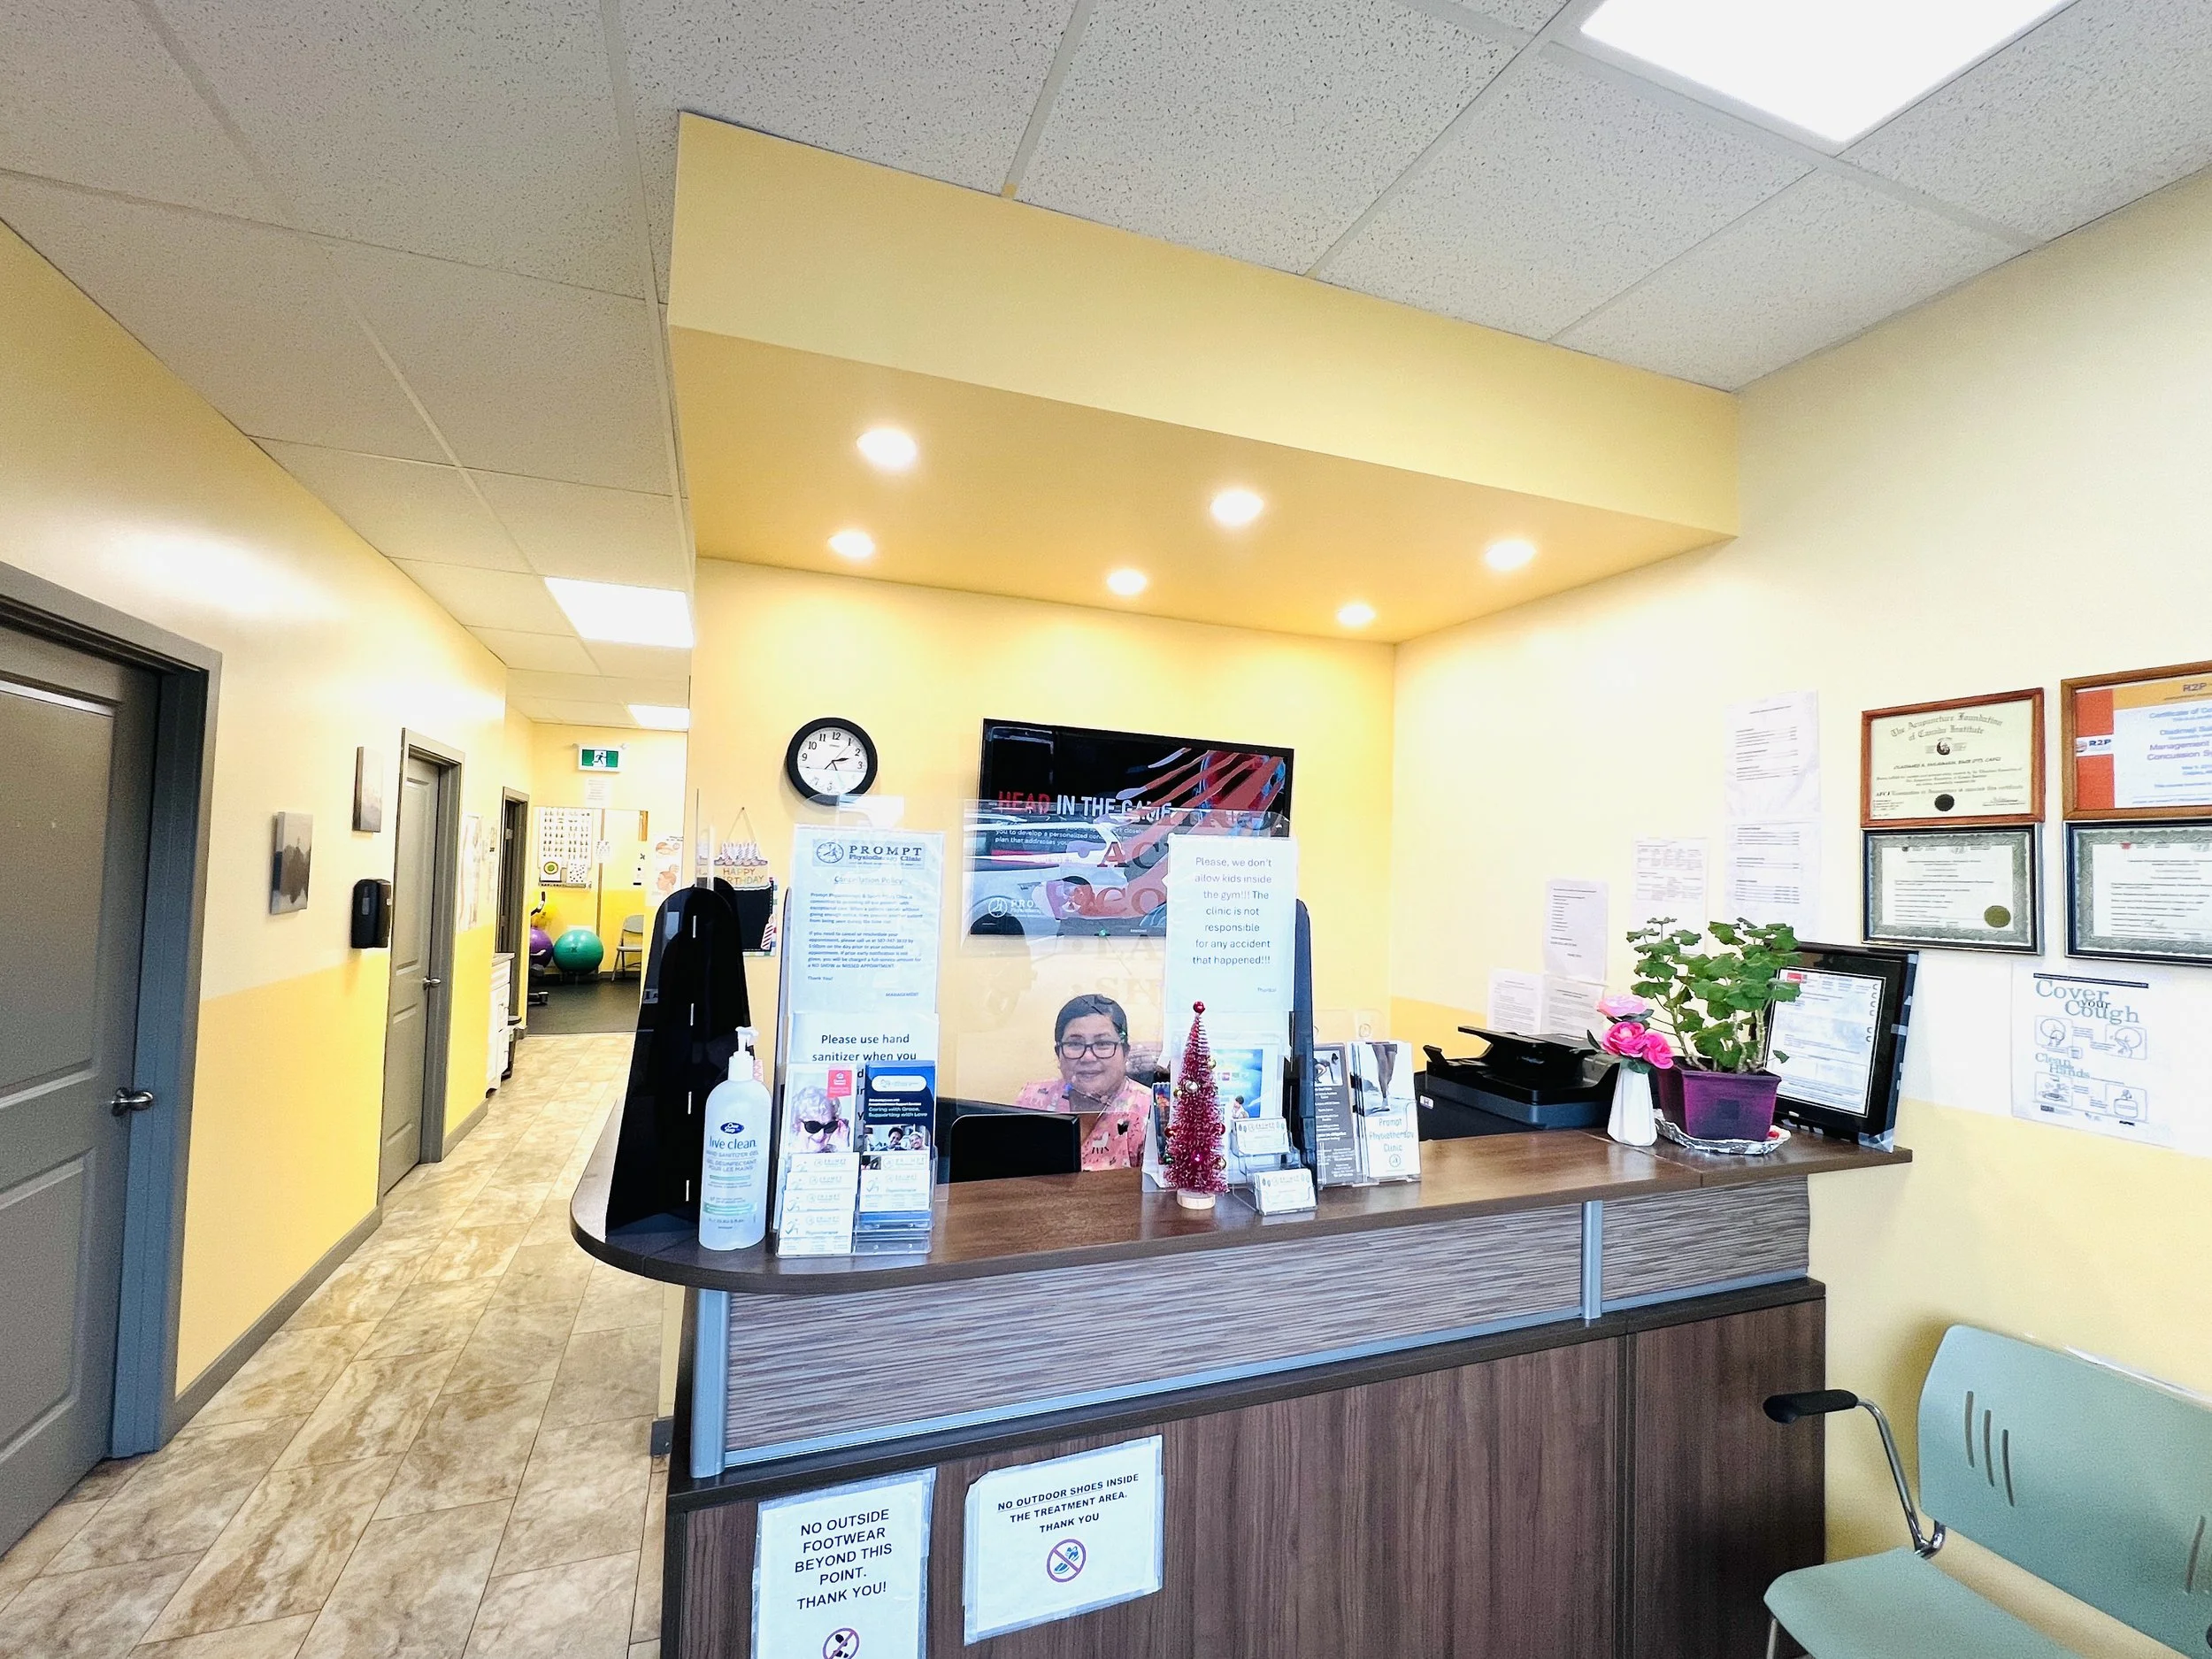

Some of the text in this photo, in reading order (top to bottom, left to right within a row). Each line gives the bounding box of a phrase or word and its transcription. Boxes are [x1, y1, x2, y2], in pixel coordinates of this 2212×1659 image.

[2183, 683, 2207, 692] R2P
[1891, 712, 2003, 737] The Acupuncture Foundation
[1950, 725, 1985, 734] Institute
[2149, 741, 2209, 750] Management
[857, 761, 863, 770] 3
[998, 791, 1050, 814] HEAD
[1056, 795, 1075, 816] IN
[1081, 796, 1117, 817] THE
[849, 845, 922, 856] PROMPT
[1195, 857, 1230, 867] Please,
[1248, 858, 1271, 867] don't
[725, 875, 764, 886] RTHDAY
[1194, 874, 1221, 883] allow
[1222, 874, 1241, 883] kids
[1221, 891, 1250, 901] gym!!!
[1252, 891, 1269, 900] The
[1206, 907, 1232, 916] clinic
[1233, 907, 1241, 916] is
[1205, 924, 1260, 933] responsible
[1210, 941, 1227, 949] any
[1230, 940, 1271, 949] accident
[1214, 956, 1271, 966] happened!!!
[2035, 979, 2109, 1002] Cover
[2080, 999, 2111, 1010] your
[2064, 999, 2140, 1025] Cough
[821, 1034, 856, 1044] Please
[882, 1033, 910, 1043] hand
[812, 1051, 917, 1062] sanitizer when you
[2035, 1053, 2071, 1067] Clean
[2049, 1064, 2091, 1079] Hands
[1379, 1118, 1402, 1128] Prompt
[710, 1136, 757, 1149] live clean
[1384, 1143, 1402, 1153] Clinic
[997, 1473, 1139, 1511] NO OUTDOOR SHOES INSIDE
[1010, 1491, 1127, 1524] THE TREATMENT AREA.
[801, 1509, 890, 1537] NO OUTSIDE
[1040, 1512, 1100, 1533] THANK YOU
[803, 1527, 886, 1554] FOOTWEAR
[795, 1543, 893, 1573] BEYOND THIS
[819, 1567, 867, 1586] POINT.
[796, 1581, 887, 1610] THANK YOU!
